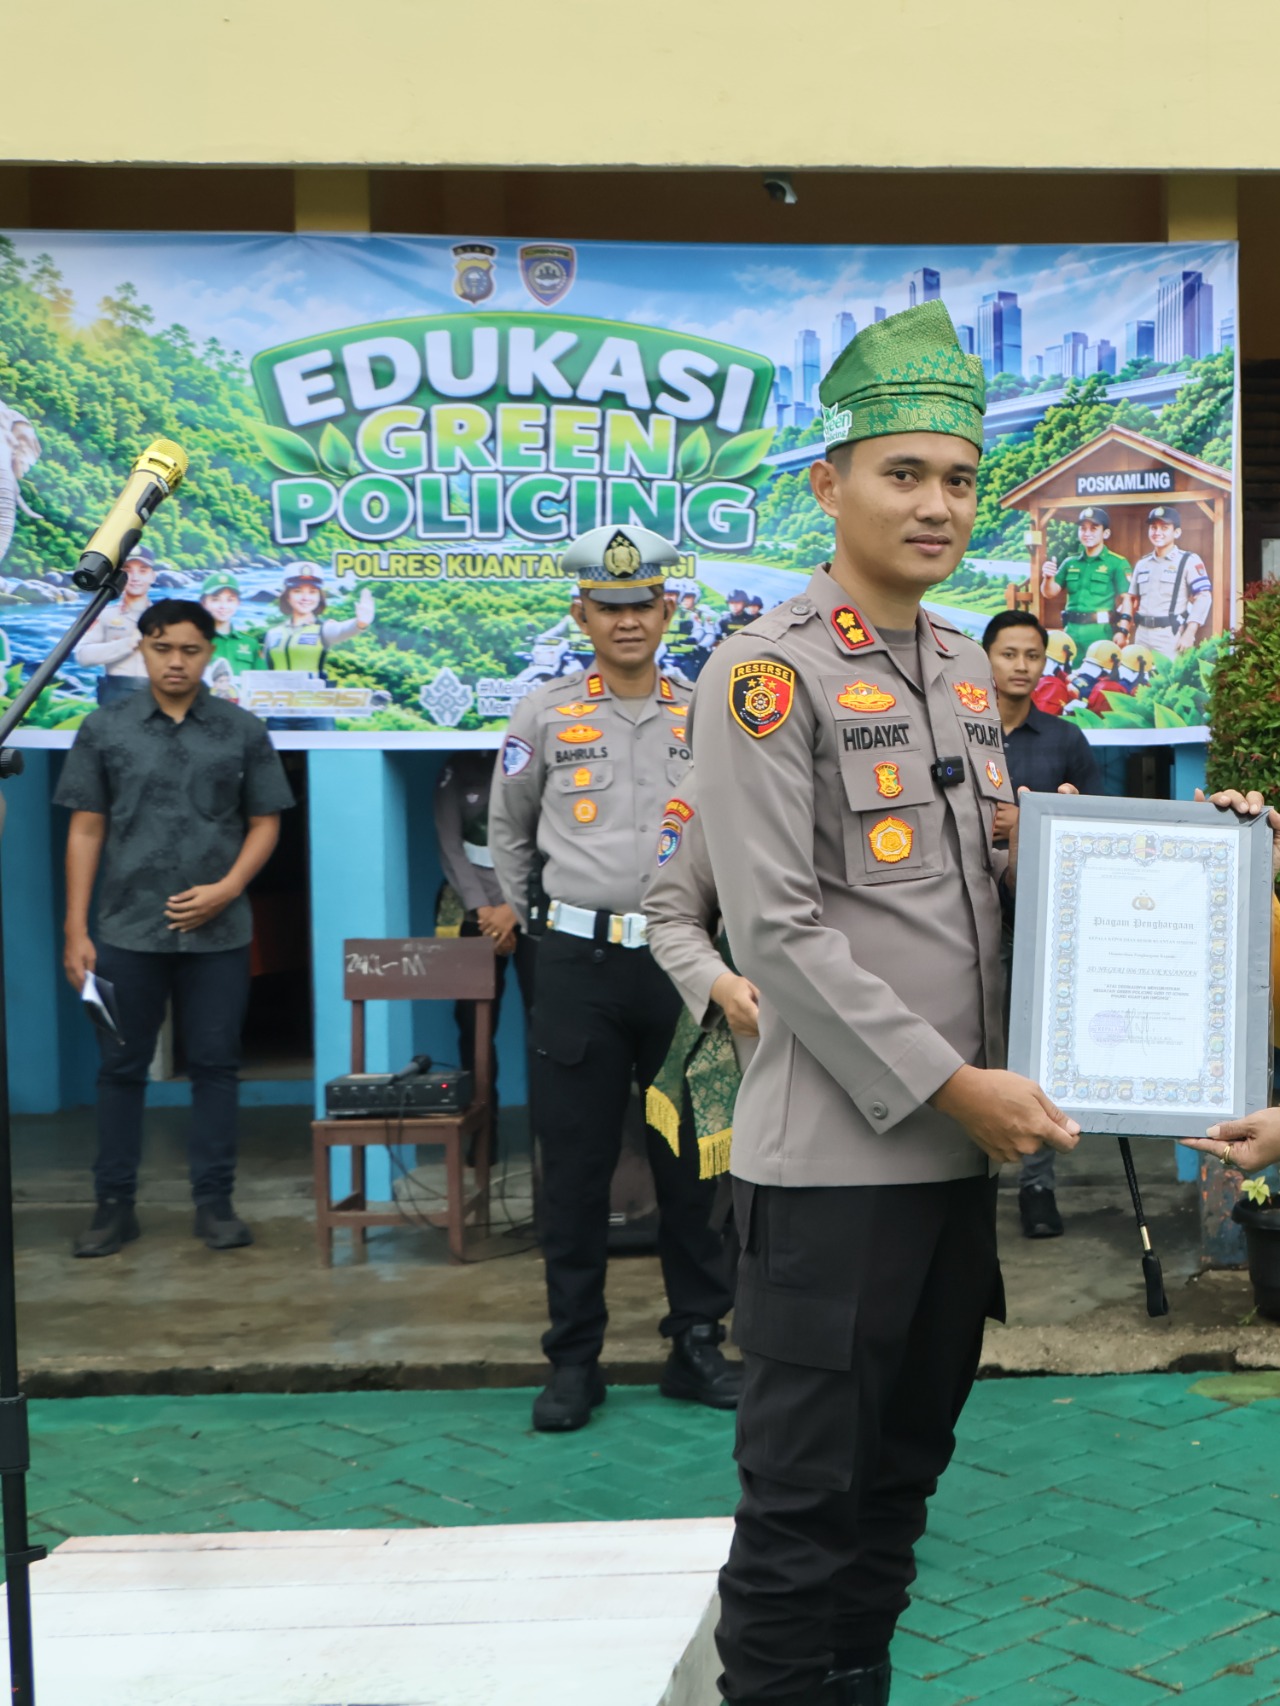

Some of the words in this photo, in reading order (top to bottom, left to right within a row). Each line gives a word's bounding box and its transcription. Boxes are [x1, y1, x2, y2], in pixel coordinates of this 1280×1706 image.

[274, 327, 755, 433] EDUKASI
[357, 403, 677, 479] GREEN
[1077, 472, 1171, 493] POSKAMLING
[272, 473, 757, 549] POLICING
[336, 553, 442, 578] POLRES
[737, 664, 789, 680] RESERSE
[843, 723, 909, 751] HIDAYAT
[964, 722, 1000, 748] POLRI
[1133, 919, 1194, 930] Penghargaan
